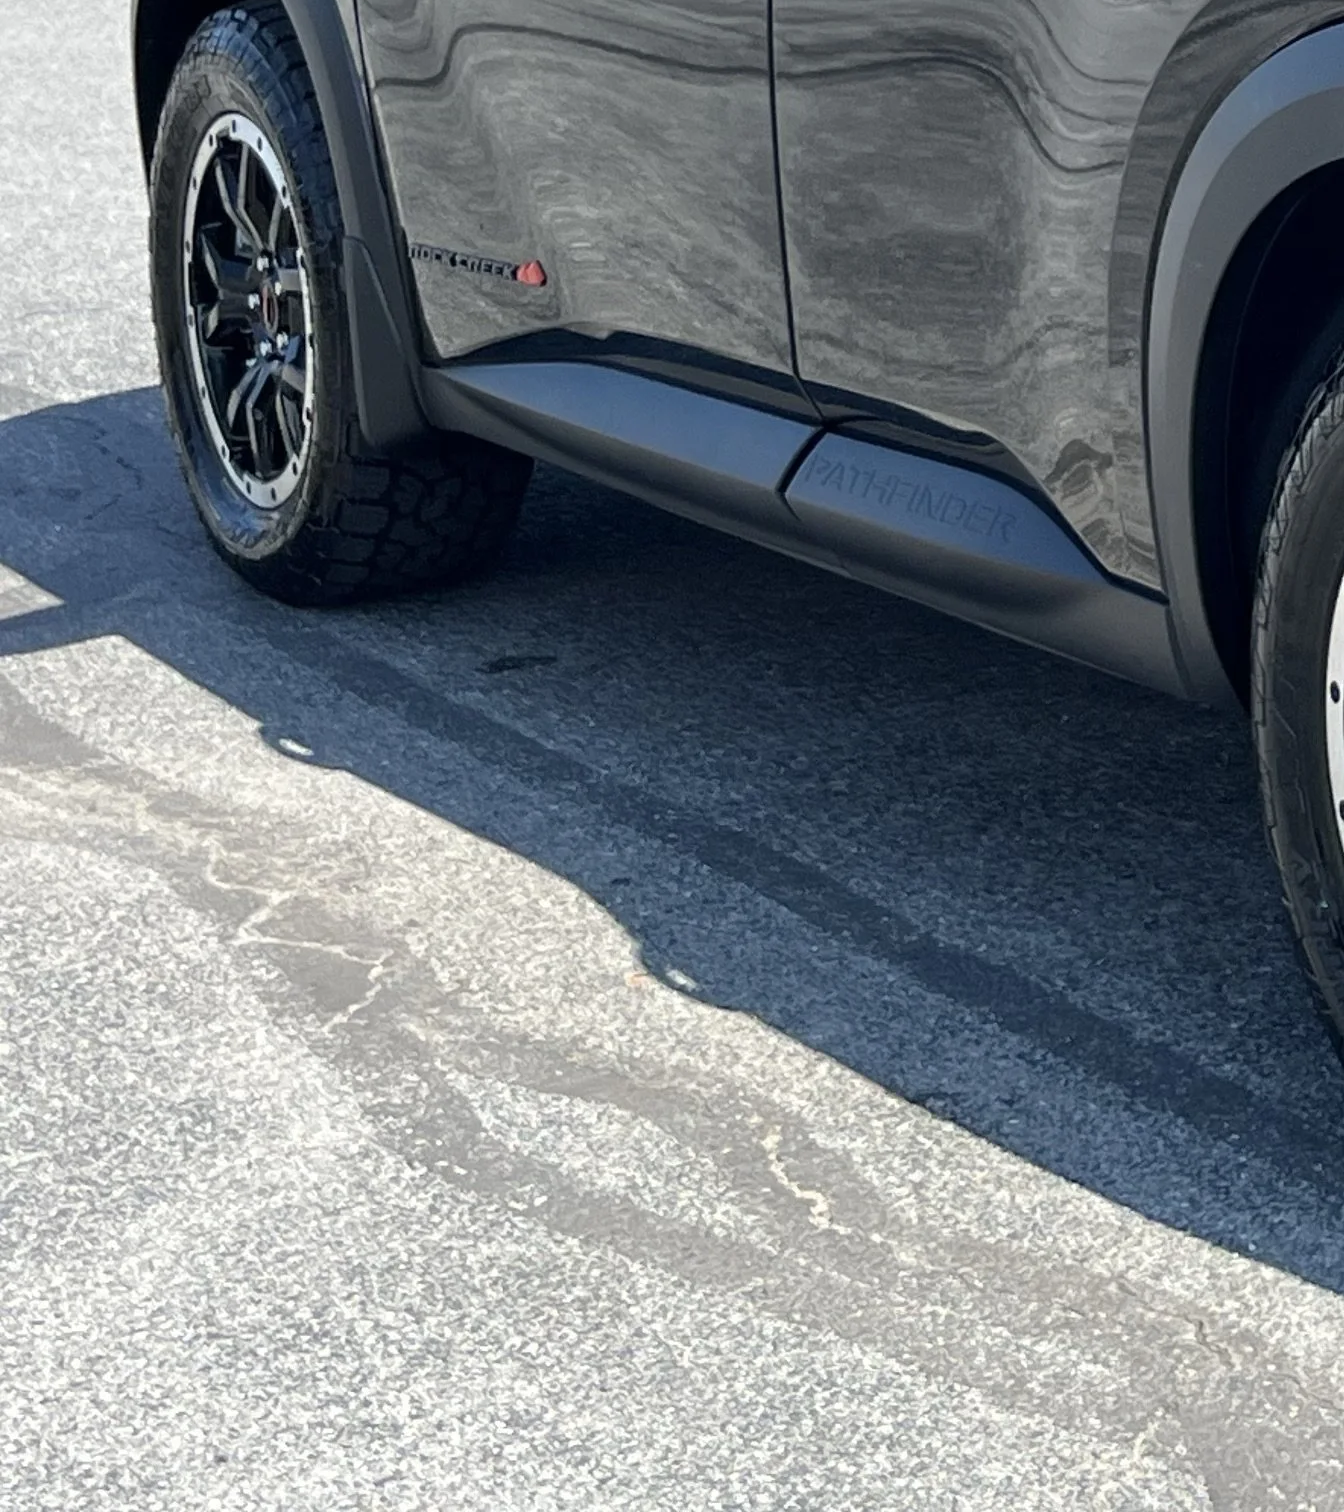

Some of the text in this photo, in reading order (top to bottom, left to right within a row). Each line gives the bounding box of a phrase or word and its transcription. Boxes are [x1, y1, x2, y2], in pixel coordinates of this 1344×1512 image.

[408, 243, 515, 281] ROCK CREEK
[804, 454, 1017, 542] PATHFINDER
